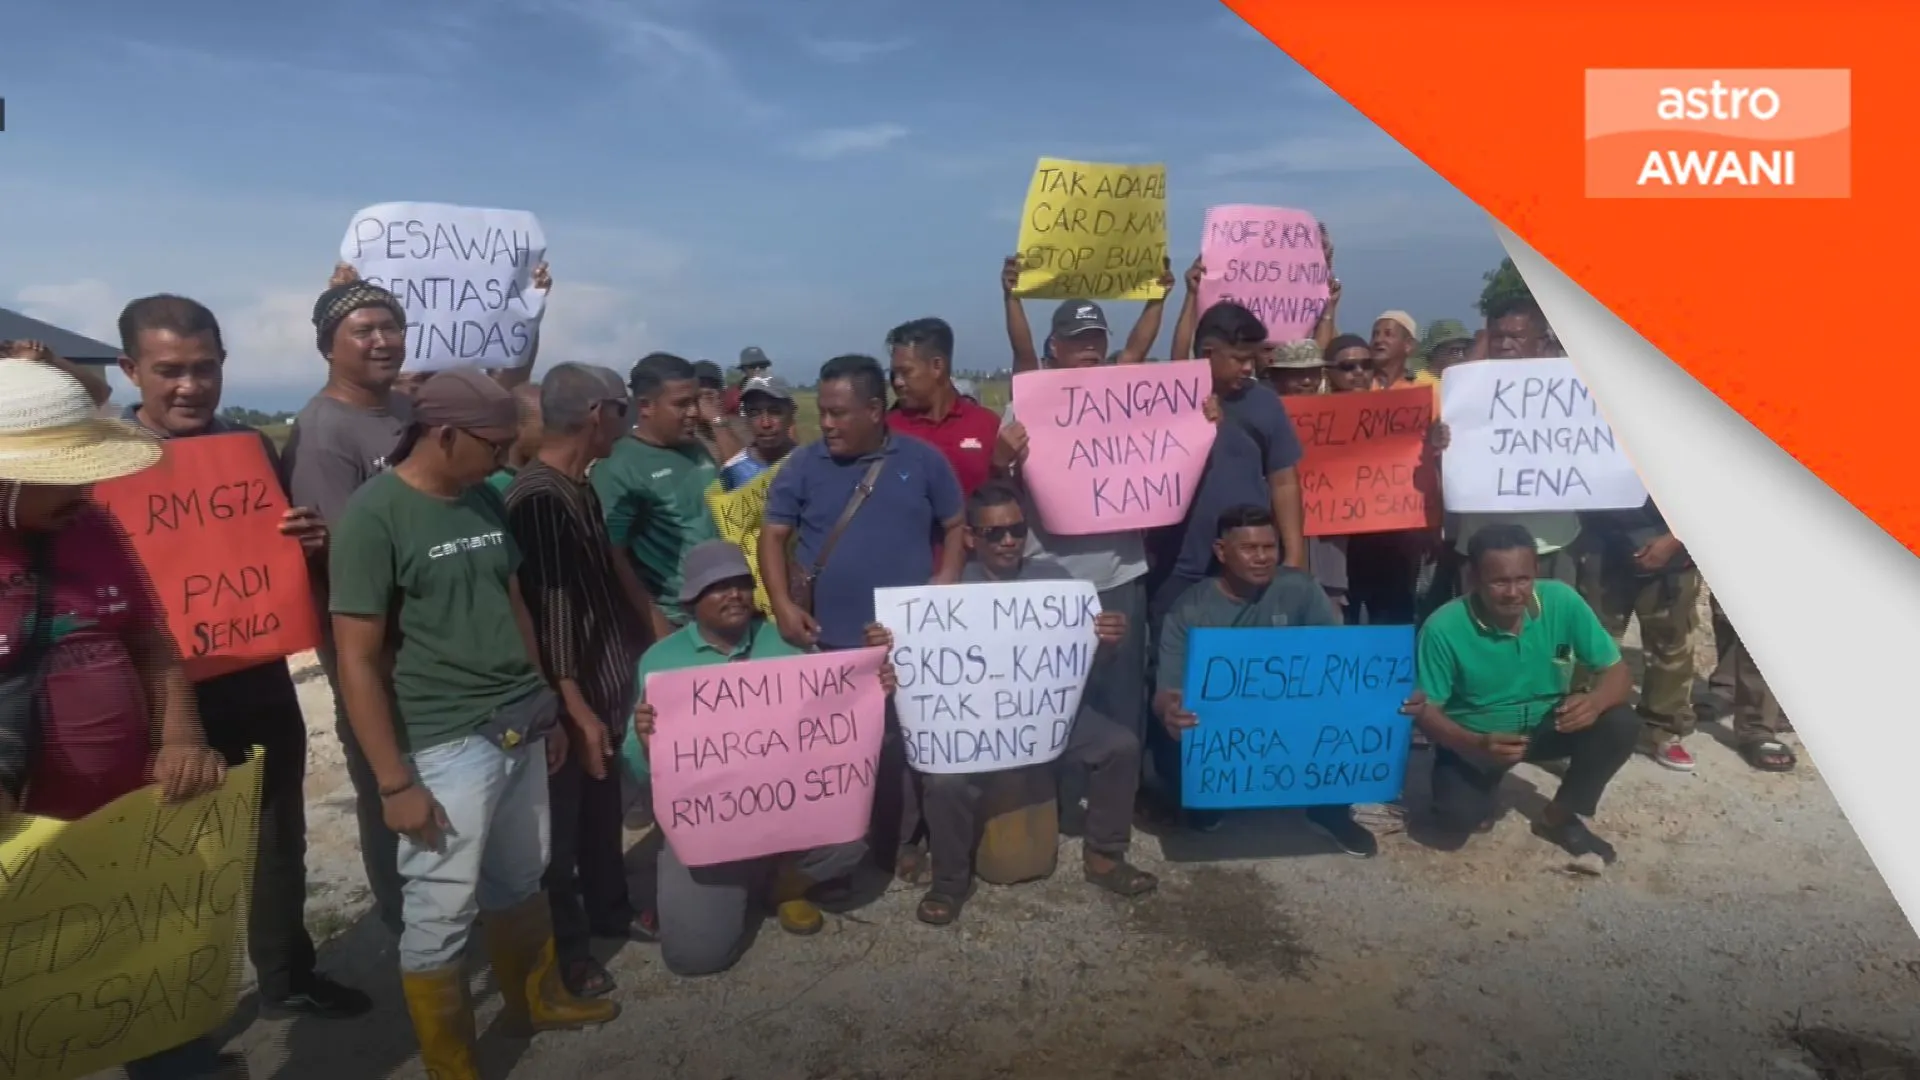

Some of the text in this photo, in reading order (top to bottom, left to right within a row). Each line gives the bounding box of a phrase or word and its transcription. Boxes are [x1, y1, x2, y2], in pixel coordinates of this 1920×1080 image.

[1040, 168, 1088, 197] TAK
[353, 217, 530, 267] PESAWAH
[1025, 242, 1166, 271] STOP BUAT
[1223, 258, 1329, 286] SKDS UNTU
[1055, 377, 1199, 428] JANGAN
[1489, 377, 1597, 420] KPKM
[1068, 429, 1191, 470] ANIAYA
[1489, 423, 1616, 455] JANGAN
[1093, 472, 1181, 517] KAMI
[1497, 466, 1592, 496] LENA
[182, 563, 271, 615] PADI
[190, 612, 281, 657] SEKILO
[897, 594, 1098, 634] TAK MASUK
[1013, 642, 1088, 682] KAMI
[1201, 655, 1313, 701] DIESEL
[692, 665, 857, 715] KAMI NAK
[912, 685, 1078, 722] TAK BUAT
[673, 710, 858, 772] HARGA PADI
[902, 724, 1038, 765] BENDANG
[1186, 725, 1393, 766] HARGA PADI
[671, 755, 879, 829] RM3000 SETAN
[1303, 760, 1391, 791] SEKILO
